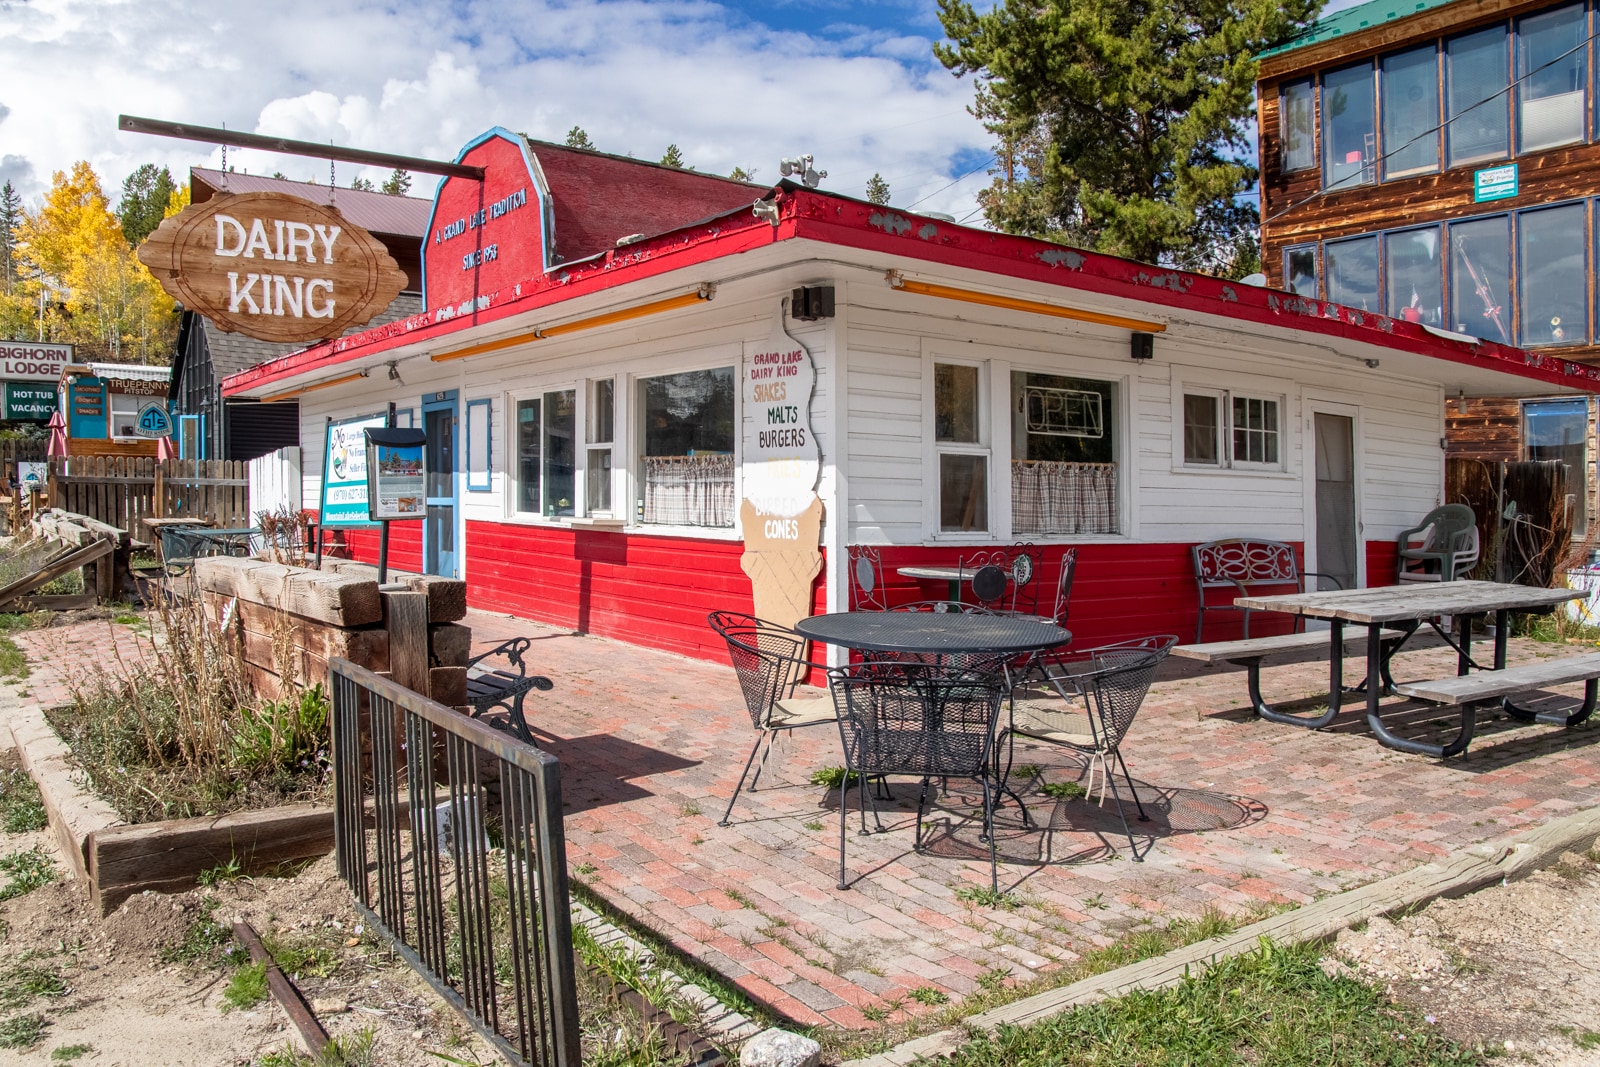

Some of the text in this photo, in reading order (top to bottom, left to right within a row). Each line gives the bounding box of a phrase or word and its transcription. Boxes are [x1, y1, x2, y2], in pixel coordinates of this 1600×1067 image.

[436, 188, 527, 244] A GRAND LAKE TRADITION
[214, 214, 341, 264] DAIRY
[462, 244, 498, 270] SINCE 1953
[227, 272, 335, 319] KING
[0, 347, 67, 361] BIGHORN
[754, 350, 803, 365] GRAND LAKE
[5, 362, 61, 375] LODGE
[751, 365, 798, 380] DAIRY KING
[13, 391, 54, 399] HOT TUB
[110, 380, 169, 390] TRUEPENNY
[124, 387, 154, 395] PITSTOP
[753, 382, 787, 403] SHAKES
[11, 404, 56, 413] VACANCY
[767, 405, 798, 425] MALTS
[1027, 389, 1101, 435] OPEN
[759, 428, 806, 448] BURGERS
[767, 455, 801, 479] FRIES
[764, 519, 799, 540] CONES
